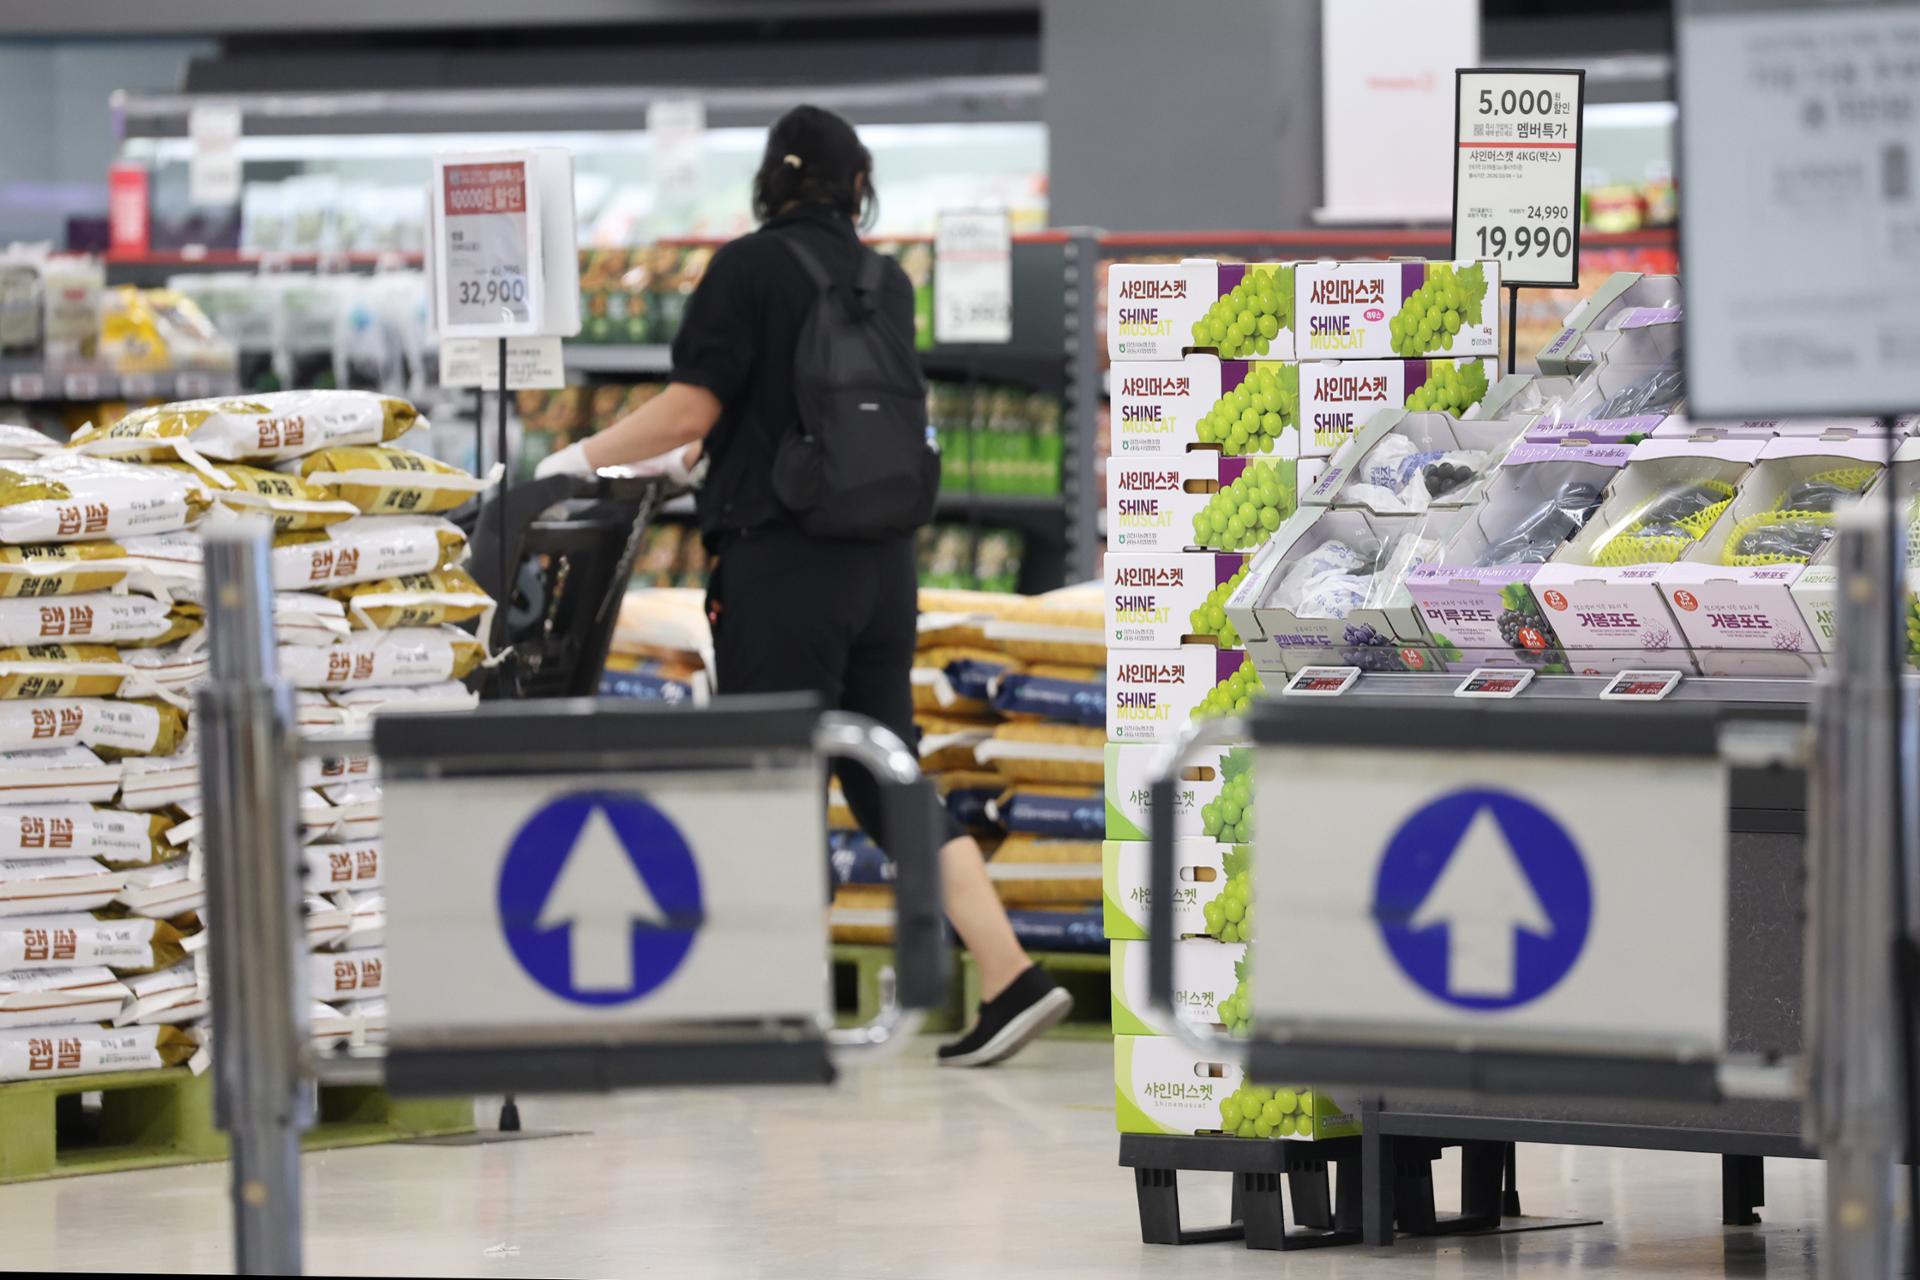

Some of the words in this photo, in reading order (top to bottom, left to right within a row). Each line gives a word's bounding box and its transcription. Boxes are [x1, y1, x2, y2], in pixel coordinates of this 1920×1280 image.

[1479, 89, 1552, 116] 5,000
[1553, 101, 1570, 115] 할인
[1517, 122, 1567, 139] 멤버특가
[1516, 151, 1561, 163] 4KG(박스)
[1527, 206, 1568, 221] 24,990
[1476, 226, 1571, 261] 19,990
[459, 279, 524, 307] 32,900
[1119, 280, 1187, 300] 샤인머스켓
[1310, 278, 1384, 304] 샤인머스켓
[1118, 308, 1158, 325] SHINE
[1310, 315, 1350, 337] SHINE
[1118, 319, 1173, 337] MUSCAT
[1310, 328, 1366, 350] MUSCAT
[1121, 376, 1190, 397] 샤인머스켓
[1314, 376, 1388, 402] 샤인머스켓
[1122, 405, 1162, 423] SHINE
[1314, 413, 1354, 434] SHINE
[256, 415, 306, 449] 햅쌀
[1122, 416, 1176, 434] MUSCAT
[1118, 471, 1179, 492] 샤인머스켓
[1118, 499, 1159, 516] SHINE
[56, 502, 109, 536] 햅쌀
[1118, 510, 1173, 528] MUSCAT
[309, 547, 360, 580] 햅쌀
[1114, 567, 1184, 587] 샤인머스켓
[1115, 595, 1156, 612] SHINE
[1547, 590, 1560, 601] 15
[1676, 591, 1690, 601] 15
[39, 605, 95, 637] 햅쌀
[1115, 606, 1170, 624] MUSCAT
[1427, 608, 1495, 625] 머루포도
[1576, 613, 1641, 628] 거봉포도
[1707, 613, 1772, 629] 거봉포도
[1523, 629, 1537, 640] 14
[326, 651, 375, 681] 햅쌀
[1116, 664, 1185, 684] 샤인머스켓
[1116, 692, 1156, 709] SHINE
[1116, 703, 1170, 721] MUSCAT
[31, 705, 83, 740] 햅쌀
[1129, 789, 1195, 808] 샤인스켓
[20, 815, 74, 849] 햅쌀
[328, 848, 377, 882] 햅쌀
[1130, 886, 1197, 905] 샤인스켓
[23, 928, 78, 961] 햅쌀
[334, 957, 383, 992] 햅쌀
[28, 1037, 82, 1072] 햅쌀
[1144, 1082, 1213, 1101] 샤인머스켓
